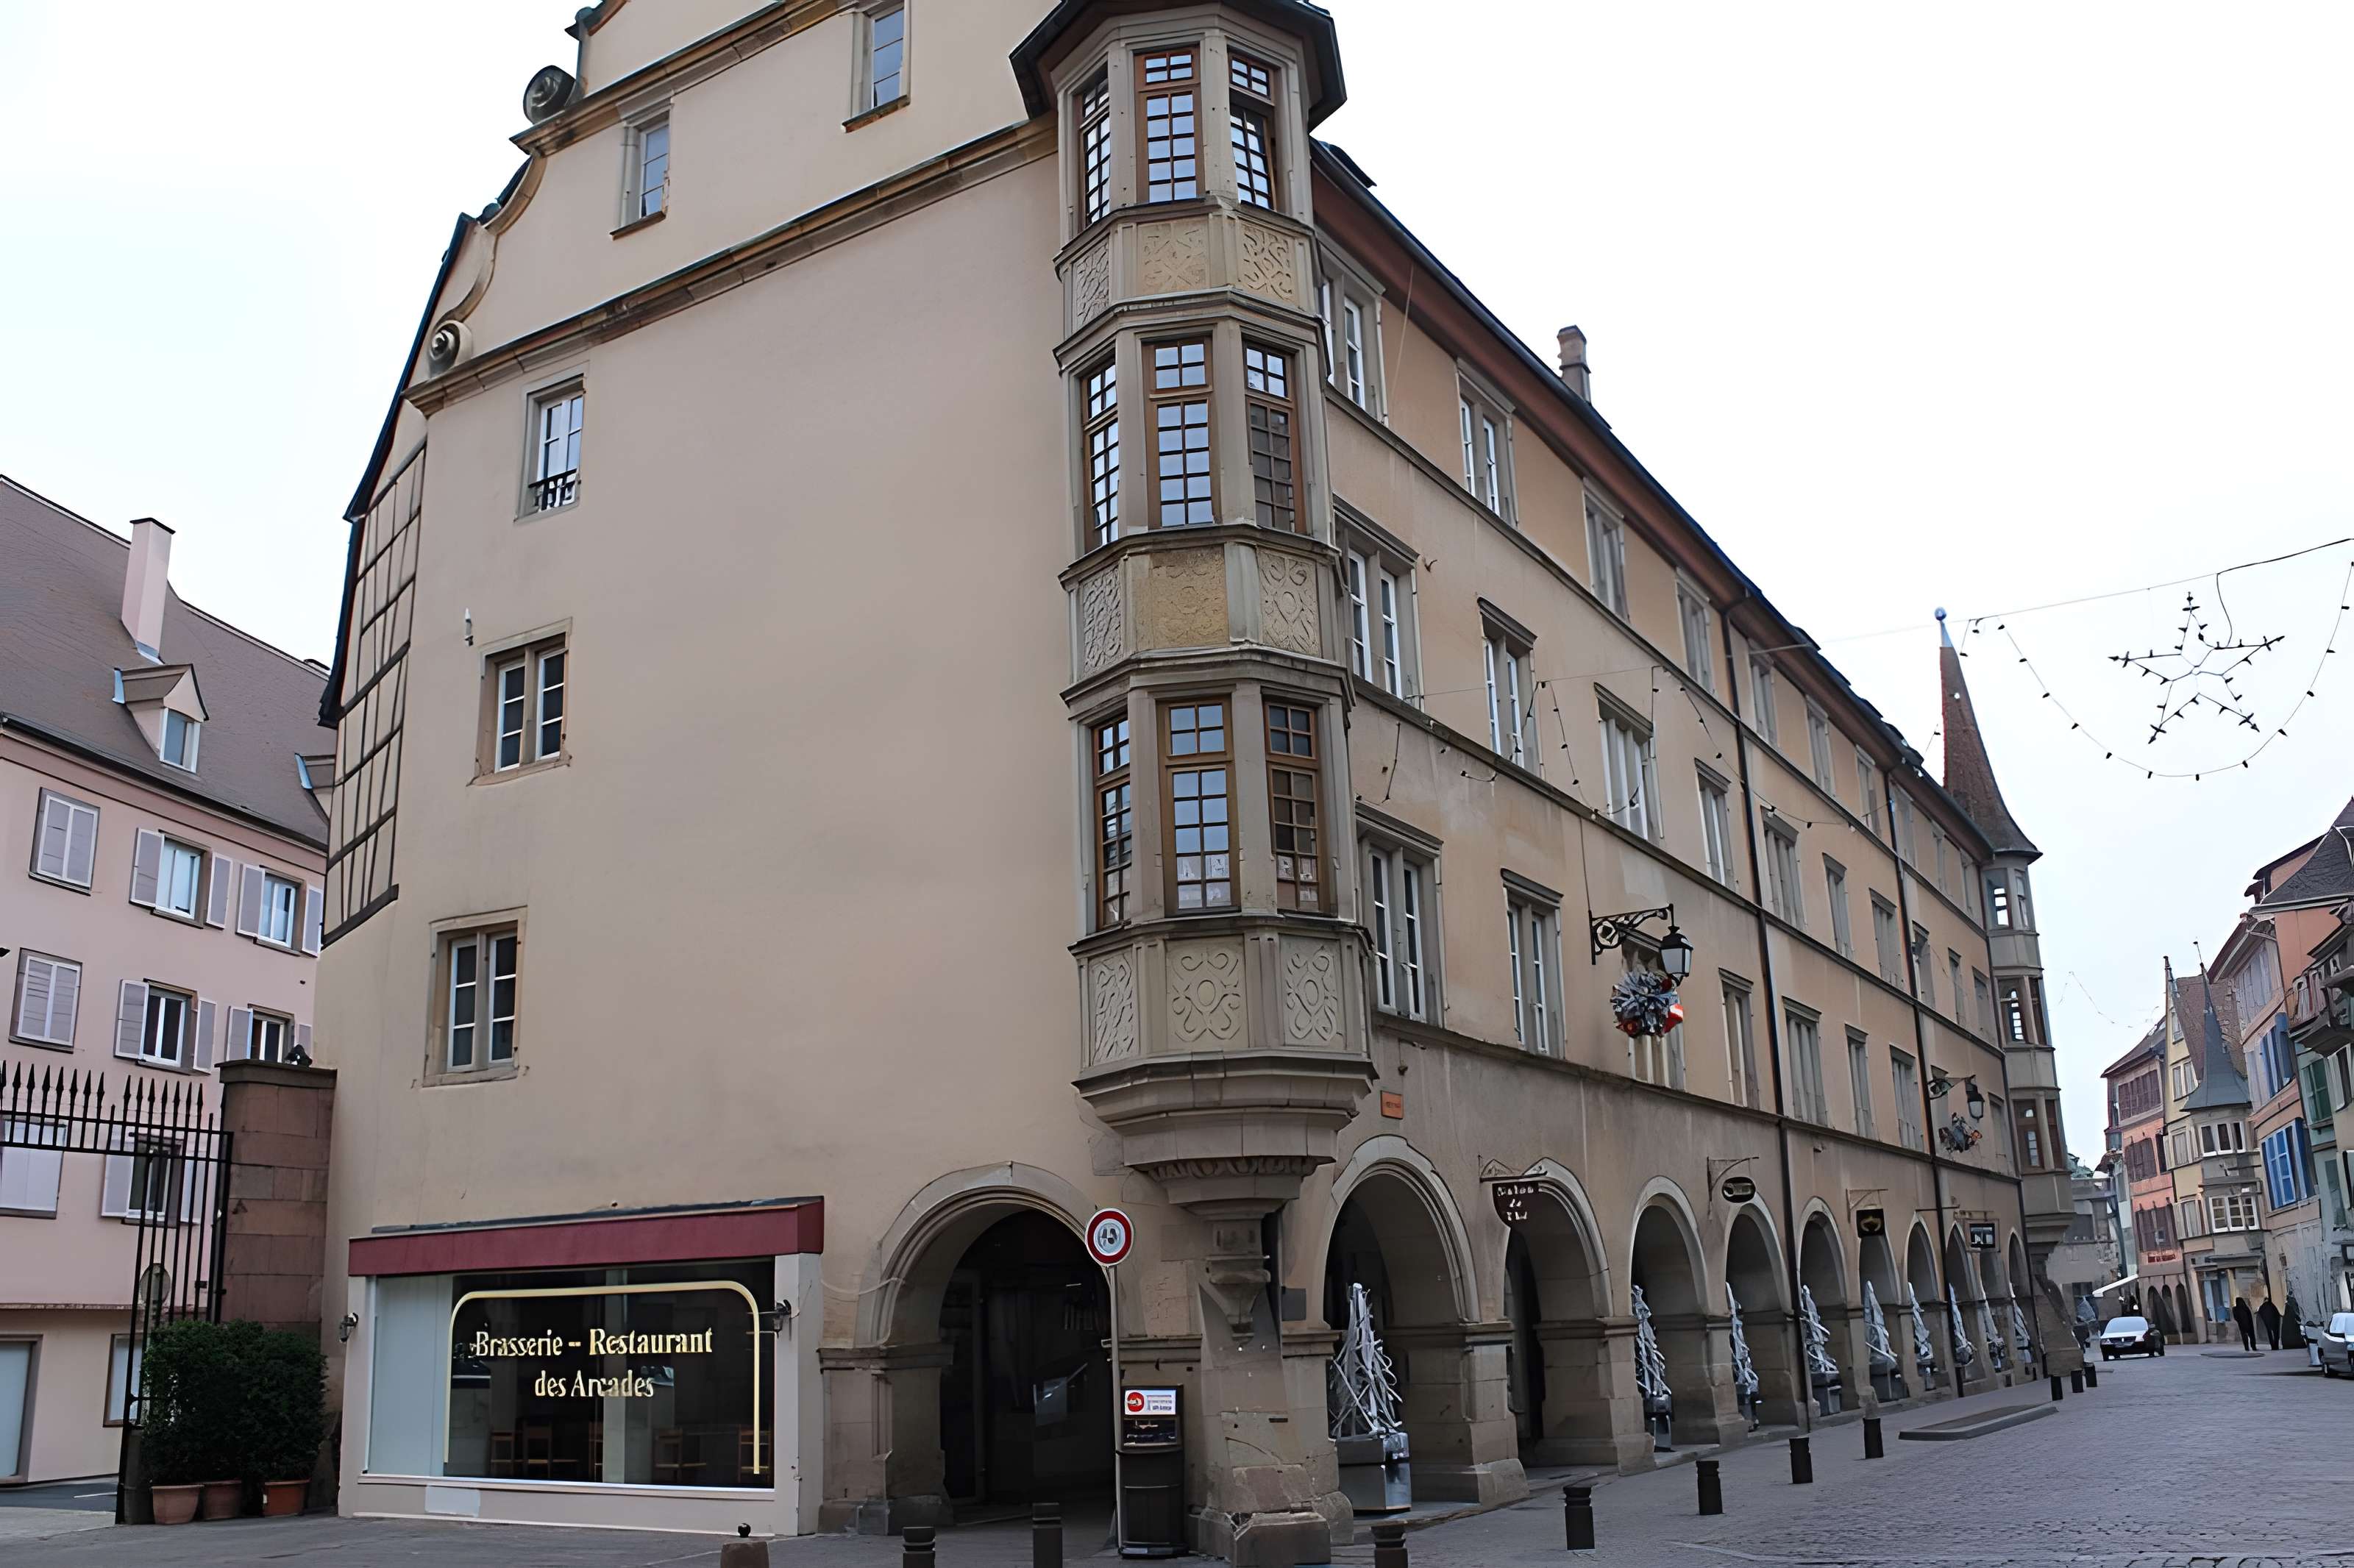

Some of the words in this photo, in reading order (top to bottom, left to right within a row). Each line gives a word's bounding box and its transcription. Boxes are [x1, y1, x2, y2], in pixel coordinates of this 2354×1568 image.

[476, 1329, 563, 1356] Brasserie
[589, 1328, 712, 1355] Restaurant
[534, 1370, 566, 1397] des
[571, 1370, 654, 1397] Arcades
